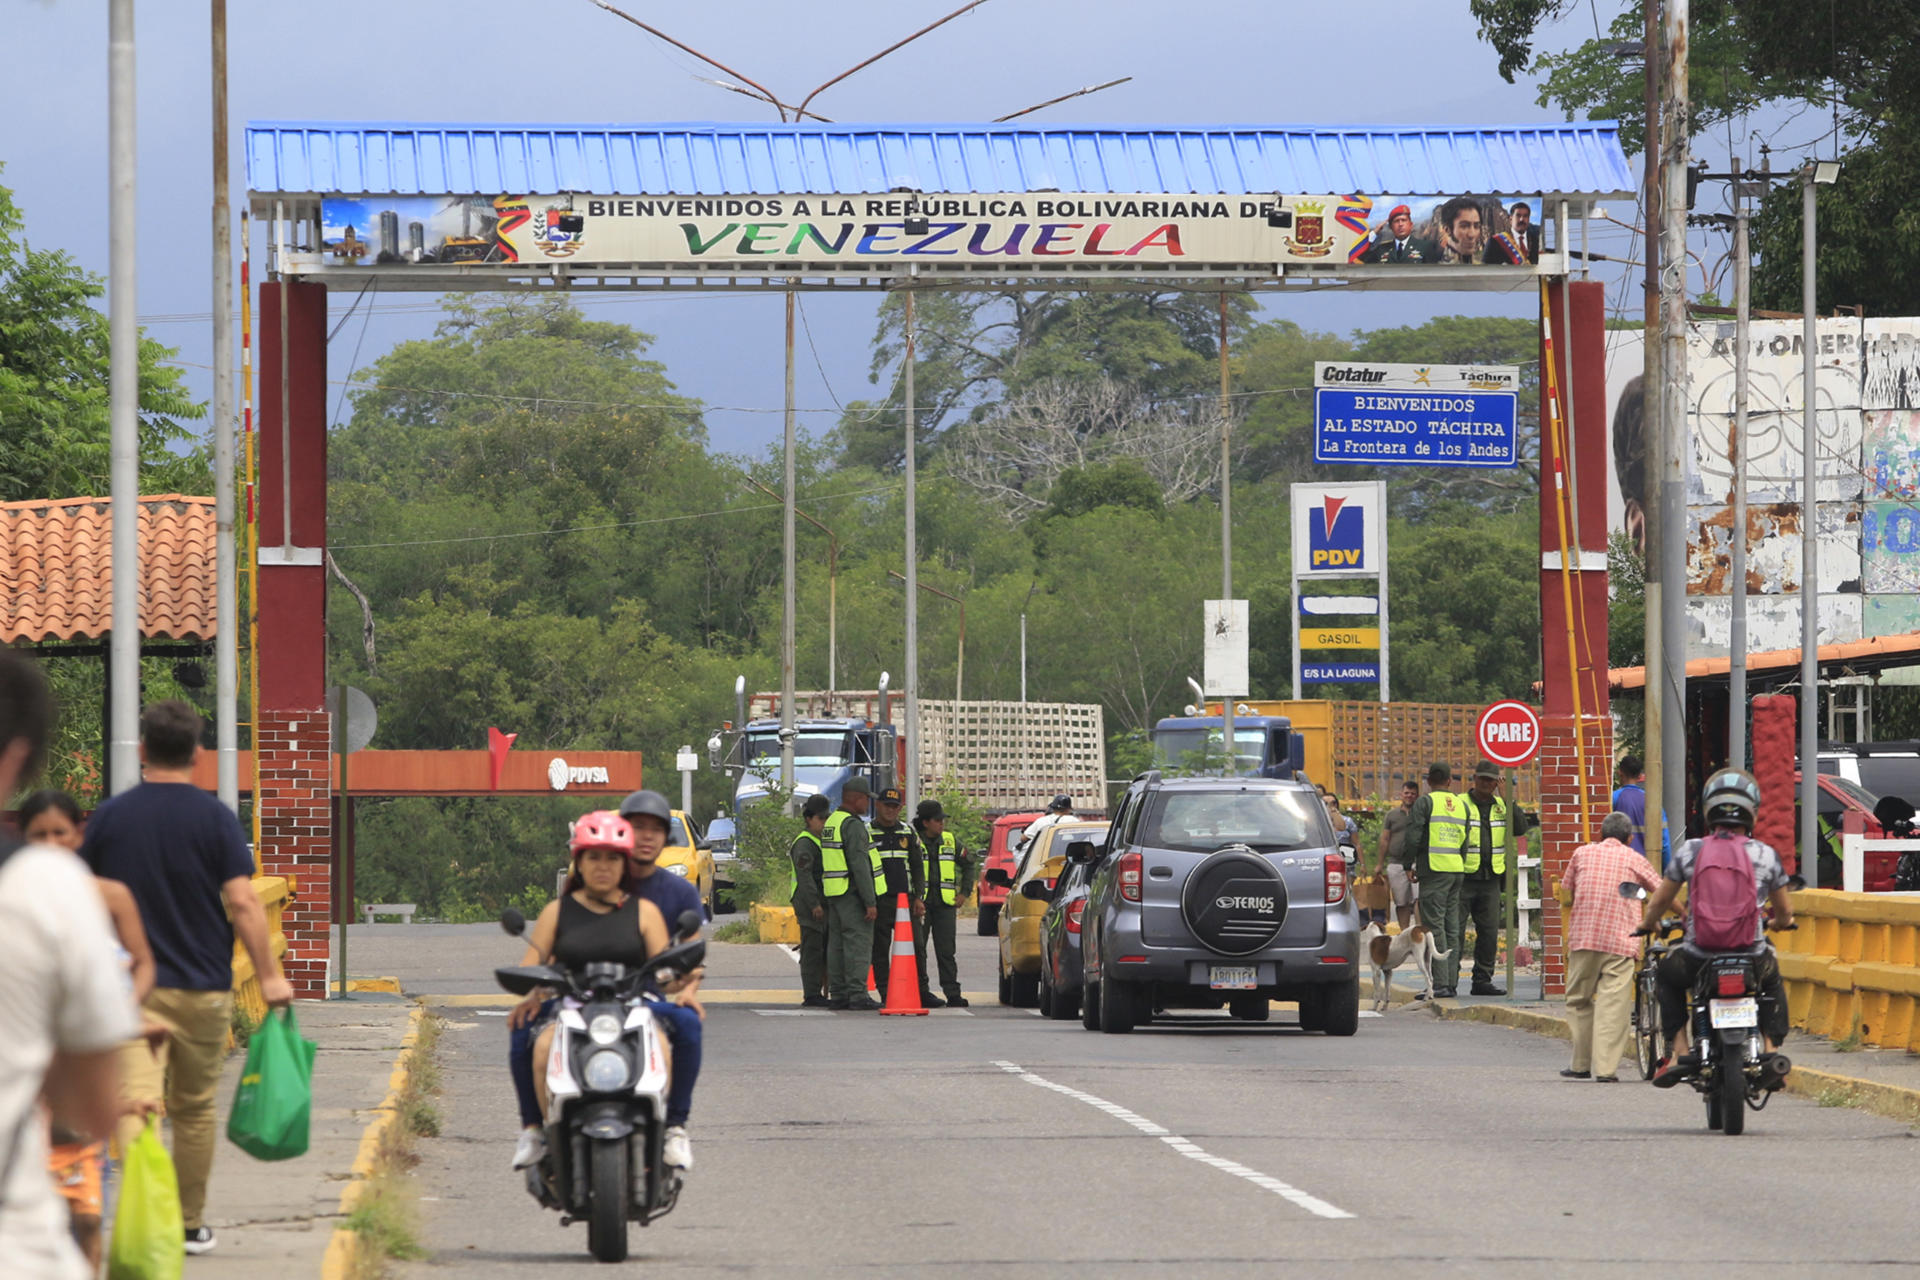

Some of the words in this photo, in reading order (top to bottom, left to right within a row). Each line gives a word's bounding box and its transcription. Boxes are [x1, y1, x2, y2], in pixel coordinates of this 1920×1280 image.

[588, 198, 783, 217] BIENVENIDOS
[792, 199, 811, 217] A
[821, 199, 856, 217] LA
[1037, 200, 1230, 218] BOLIVARIANA
[1240, 200, 1272, 218] DE
[679, 223, 1185, 255] VENEZUELA
[1323, 366, 1387, 382] Cotatur
[1460, 371, 1511, 382] Táchira
[1354, 396, 1475, 413] BIENVENIDOS
[1323, 419, 1347, 432] AL
[1351, 419, 1418, 434] ESTADO
[1428, 417, 1506, 436] TÁCHIRA
[1323, 439, 1339, 453] La
[1344, 440, 1407, 455] Frontera
[1414, 441, 1431, 455] de
[1438, 442, 1462, 456] los
[1468, 442, 1509, 458] Andes
[1313, 549, 1361, 566] PDV
[1318, 634, 1361, 644] GASOIL
[1304, 668, 1319, 678] E/S
[1321, 668, 1334, 678] LA
[1336, 668, 1376, 678] LAGUNA
[1487, 723, 1532, 742] PARE
[568, 766, 610, 784] PDVSA
[1233, 896, 1274, 909] TERIOS
